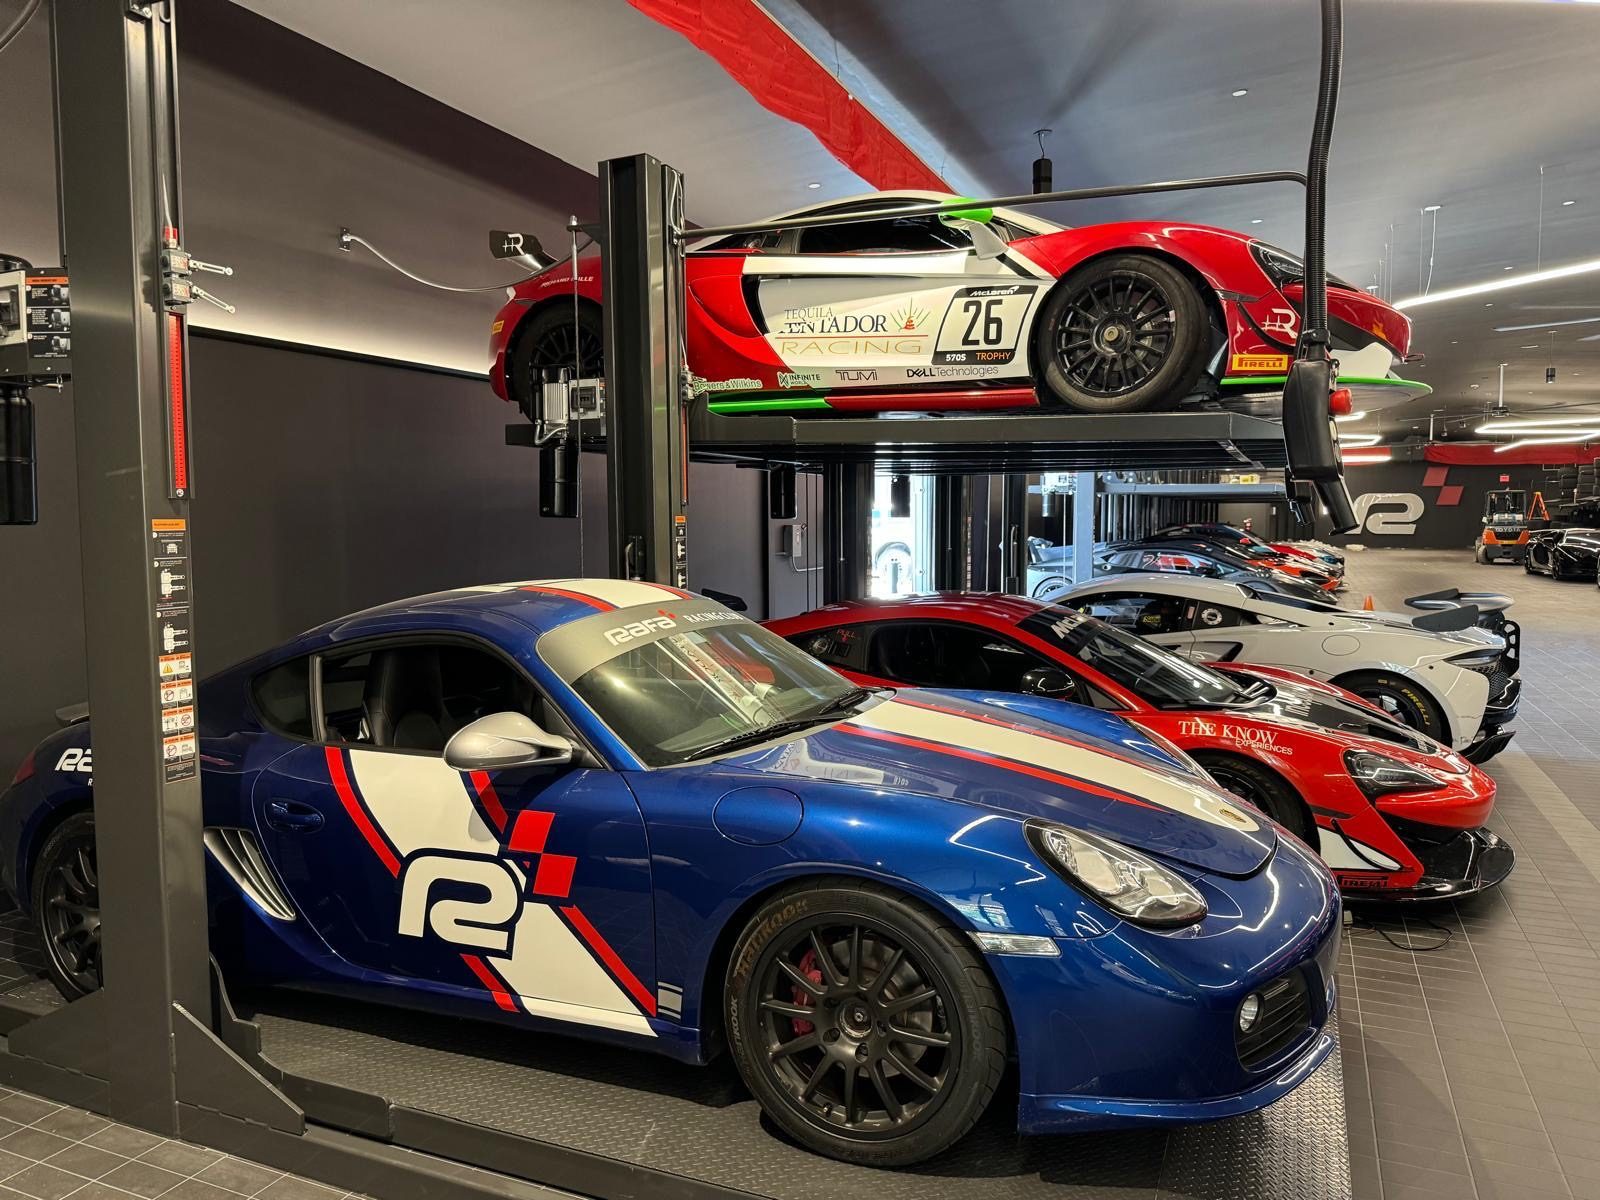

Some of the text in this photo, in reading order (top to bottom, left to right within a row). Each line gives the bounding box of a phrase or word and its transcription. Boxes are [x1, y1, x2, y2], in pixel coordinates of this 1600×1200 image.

[970, 287, 1015, 296] McLaren
[784, 307, 834, 321] TEQUILA
[961, 298, 1004, 347] 26
[781, 340, 922, 355] RACING
[945, 352, 1012, 362] 570S TROPHY
[1237, 357, 1284, 368] PIRELLI
[789, 373, 821, 381] INFINITE
[835, 368, 878, 381] TUMI
[906, 366, 999, 378] DELL Technologies
[1401, 689, 1431, 726] PIRELLI
[1178, 720, 1279, 745] THE KNOW
[1235, 738, 1294, 756] EXPERIENCES
